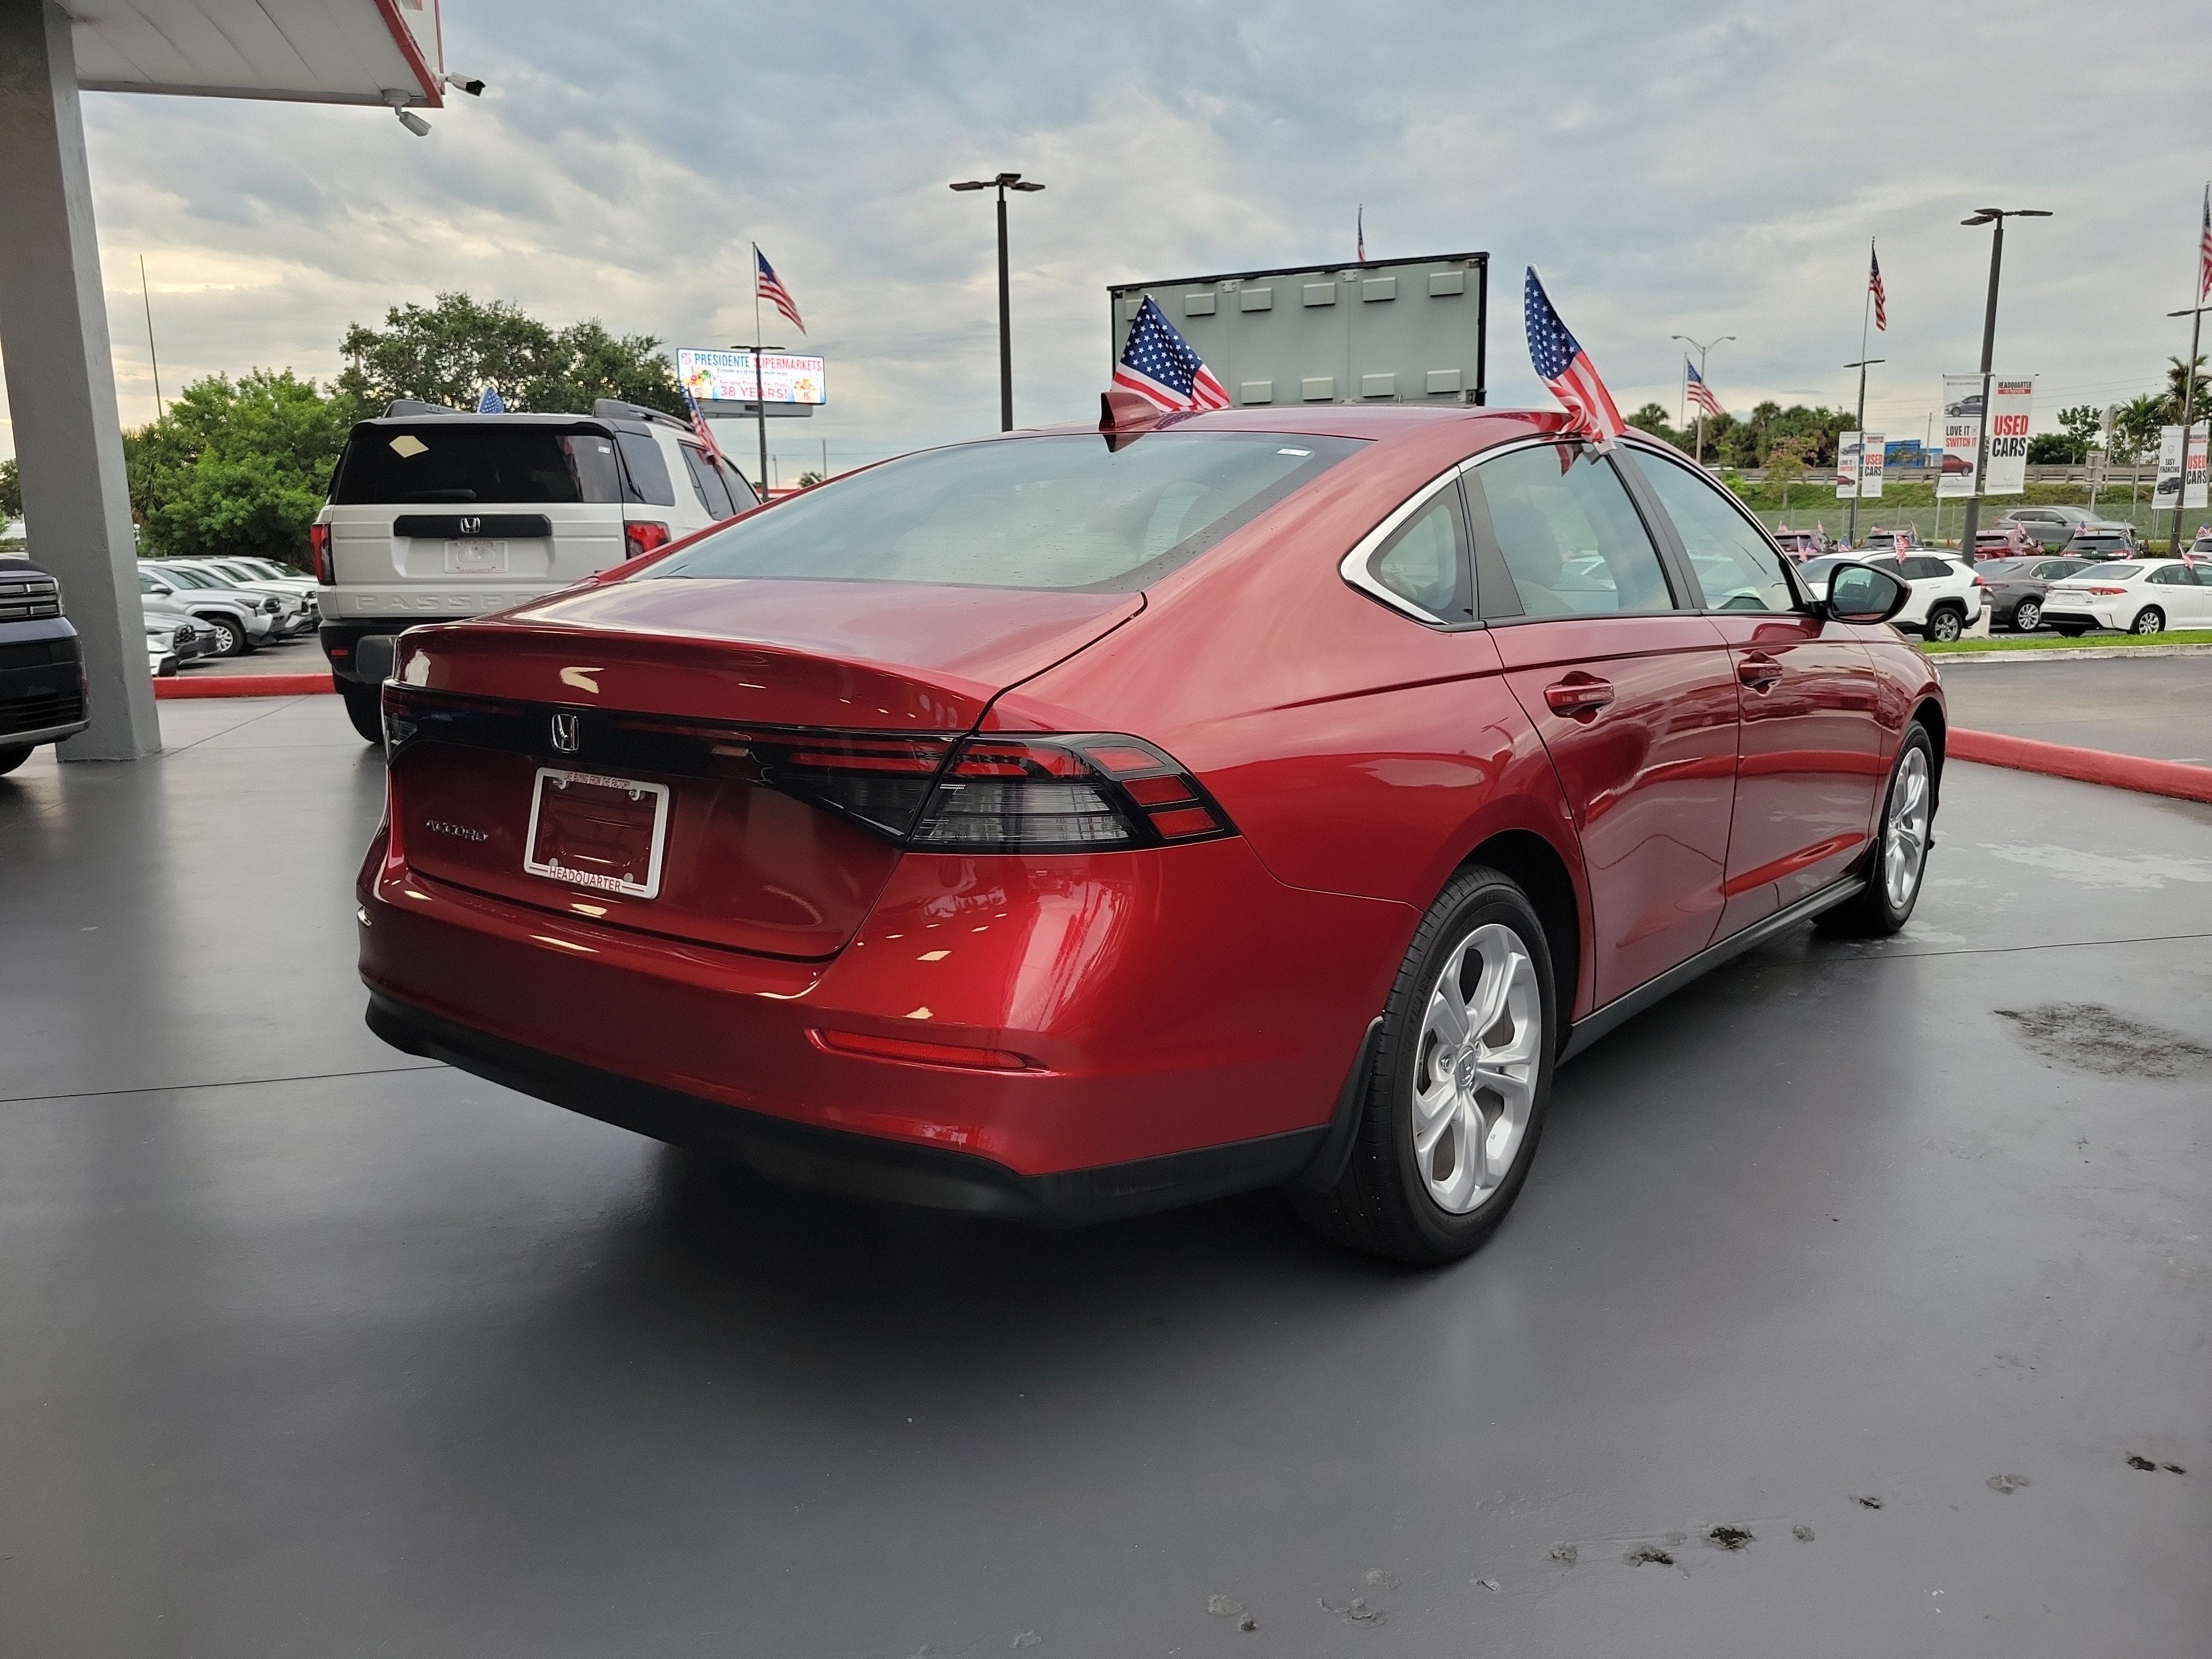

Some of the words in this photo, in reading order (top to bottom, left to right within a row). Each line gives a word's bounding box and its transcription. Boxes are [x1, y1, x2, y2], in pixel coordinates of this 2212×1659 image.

[695, 353, 750, 368] PRESIDENTE
[720, 386, 735, 396] 38
[1946, 426, 1962, 436] LOVE
[1964, 426, 1970, 436] IT
[1994, 415, 2029, 436] USED
[1945, 437, 1971, 448] SWITCH
[1972, 437, 1977, 447] IT
[1991, 437, 2026, 458] CARS
[1866, 454, 1883, 465] USED
[2188, 455, 2206, 470] USED
[1864, 466, 1882, 477] CARS
[2186, 470, 2207, 485] CARS
[355, 594, 538, 610] PASSPO
[426, 819, 488, 842] ACCORD
[549, 866, 621, 891] HEADQUARTER
